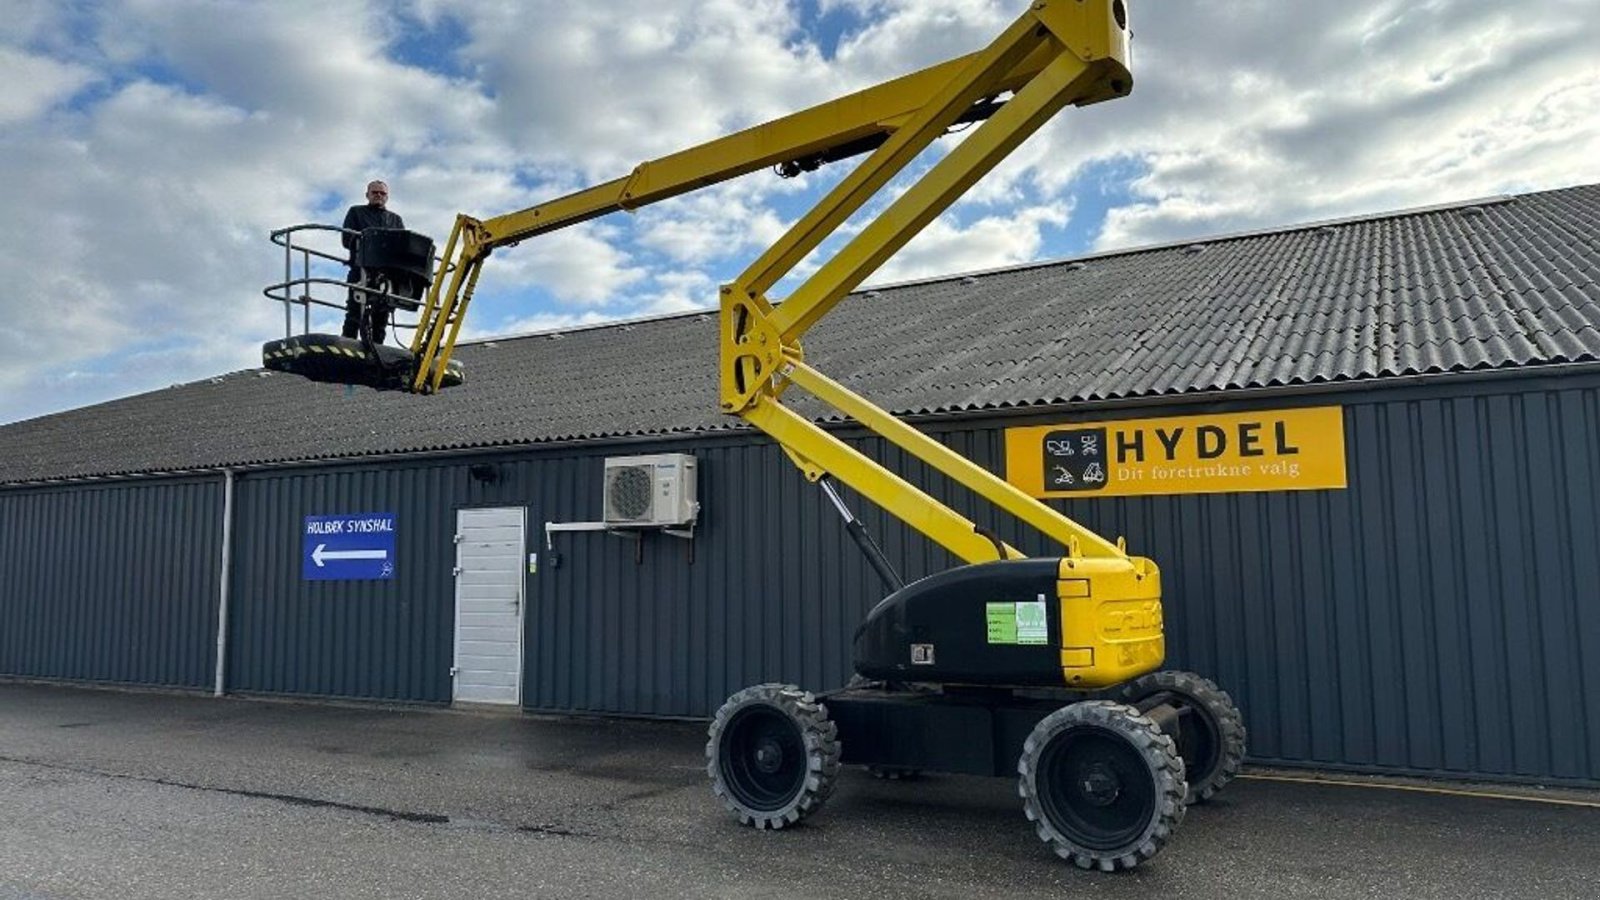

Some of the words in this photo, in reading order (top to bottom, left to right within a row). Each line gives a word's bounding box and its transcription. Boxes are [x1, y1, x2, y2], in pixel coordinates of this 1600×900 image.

[1116, 421, 1299, 463] HYDEL
[1117, 467, 1144, 481] Dit
[1151, 463, 1252, 480] foretrukne
[1259, 460, 1301, 477] valg
[307, 520, 345, 534] HOLBÆK
[347, 518, 393, 533] SYNSHAL
